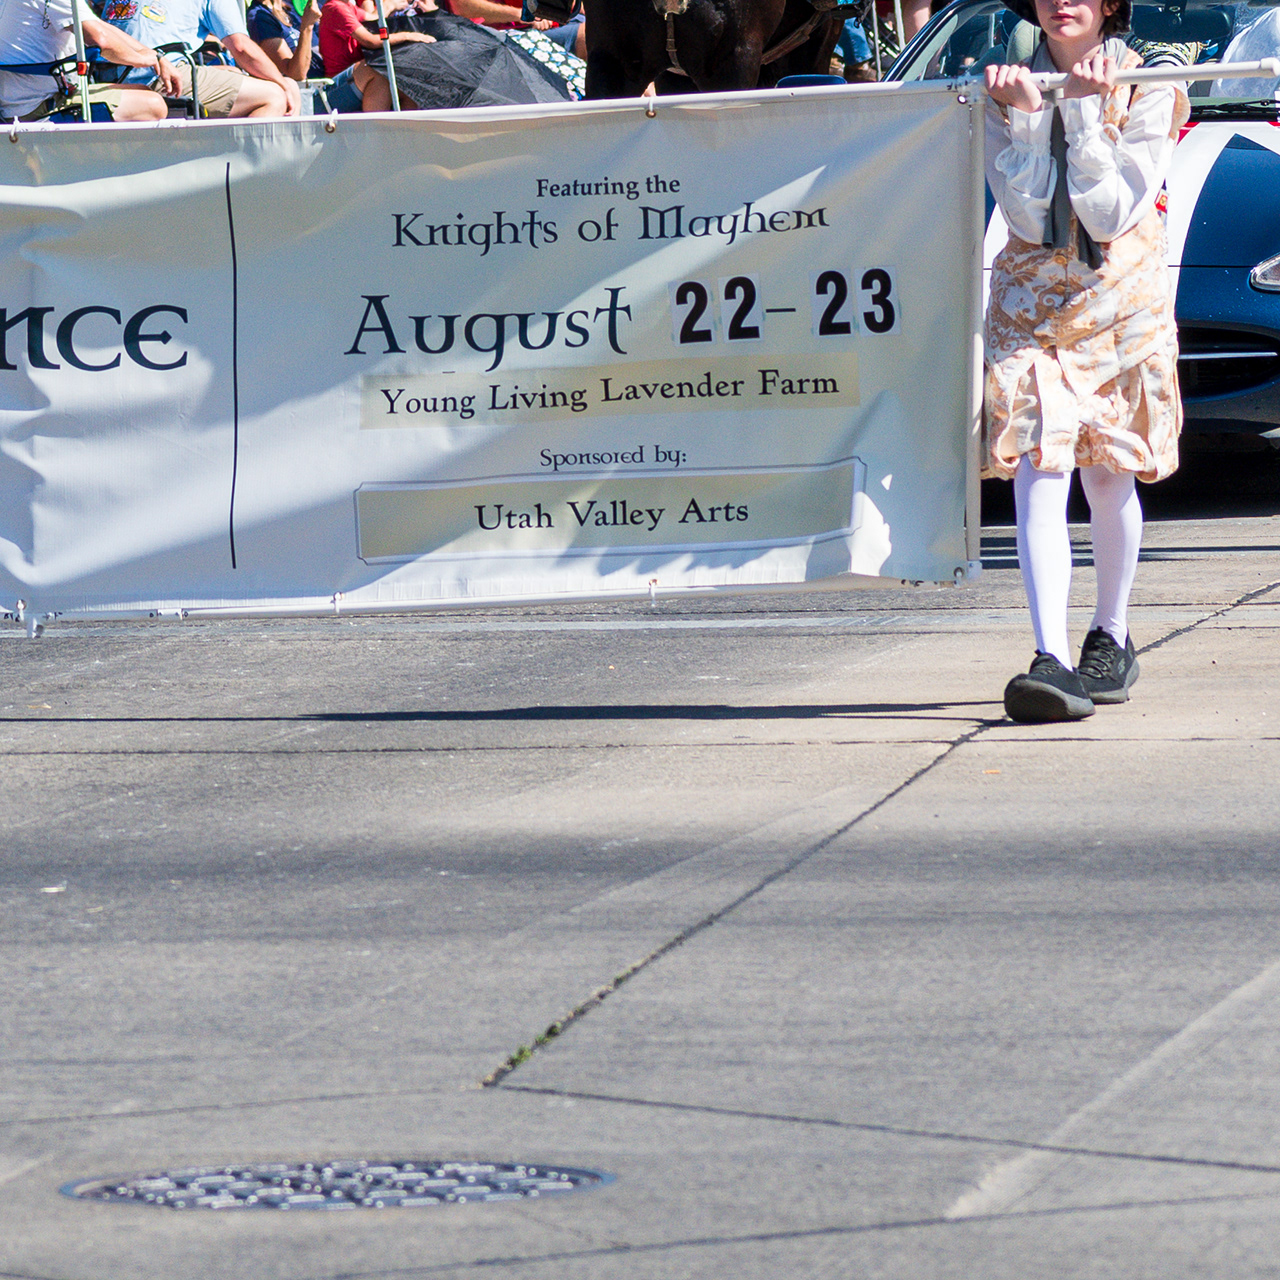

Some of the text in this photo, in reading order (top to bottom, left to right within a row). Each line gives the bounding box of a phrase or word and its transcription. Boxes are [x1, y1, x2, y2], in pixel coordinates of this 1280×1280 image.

[536, 175, 681, 201] Featuring the
[391, 201, 831, 257] Knights of Mayhem
[343, 286, 633, 373] August
[380, 369, 840, 420] Young Living Lavender Farm
[540, 444, 688, 472] Sponsored by:
[474, 497, 749, 532] Utah Valley Arts
